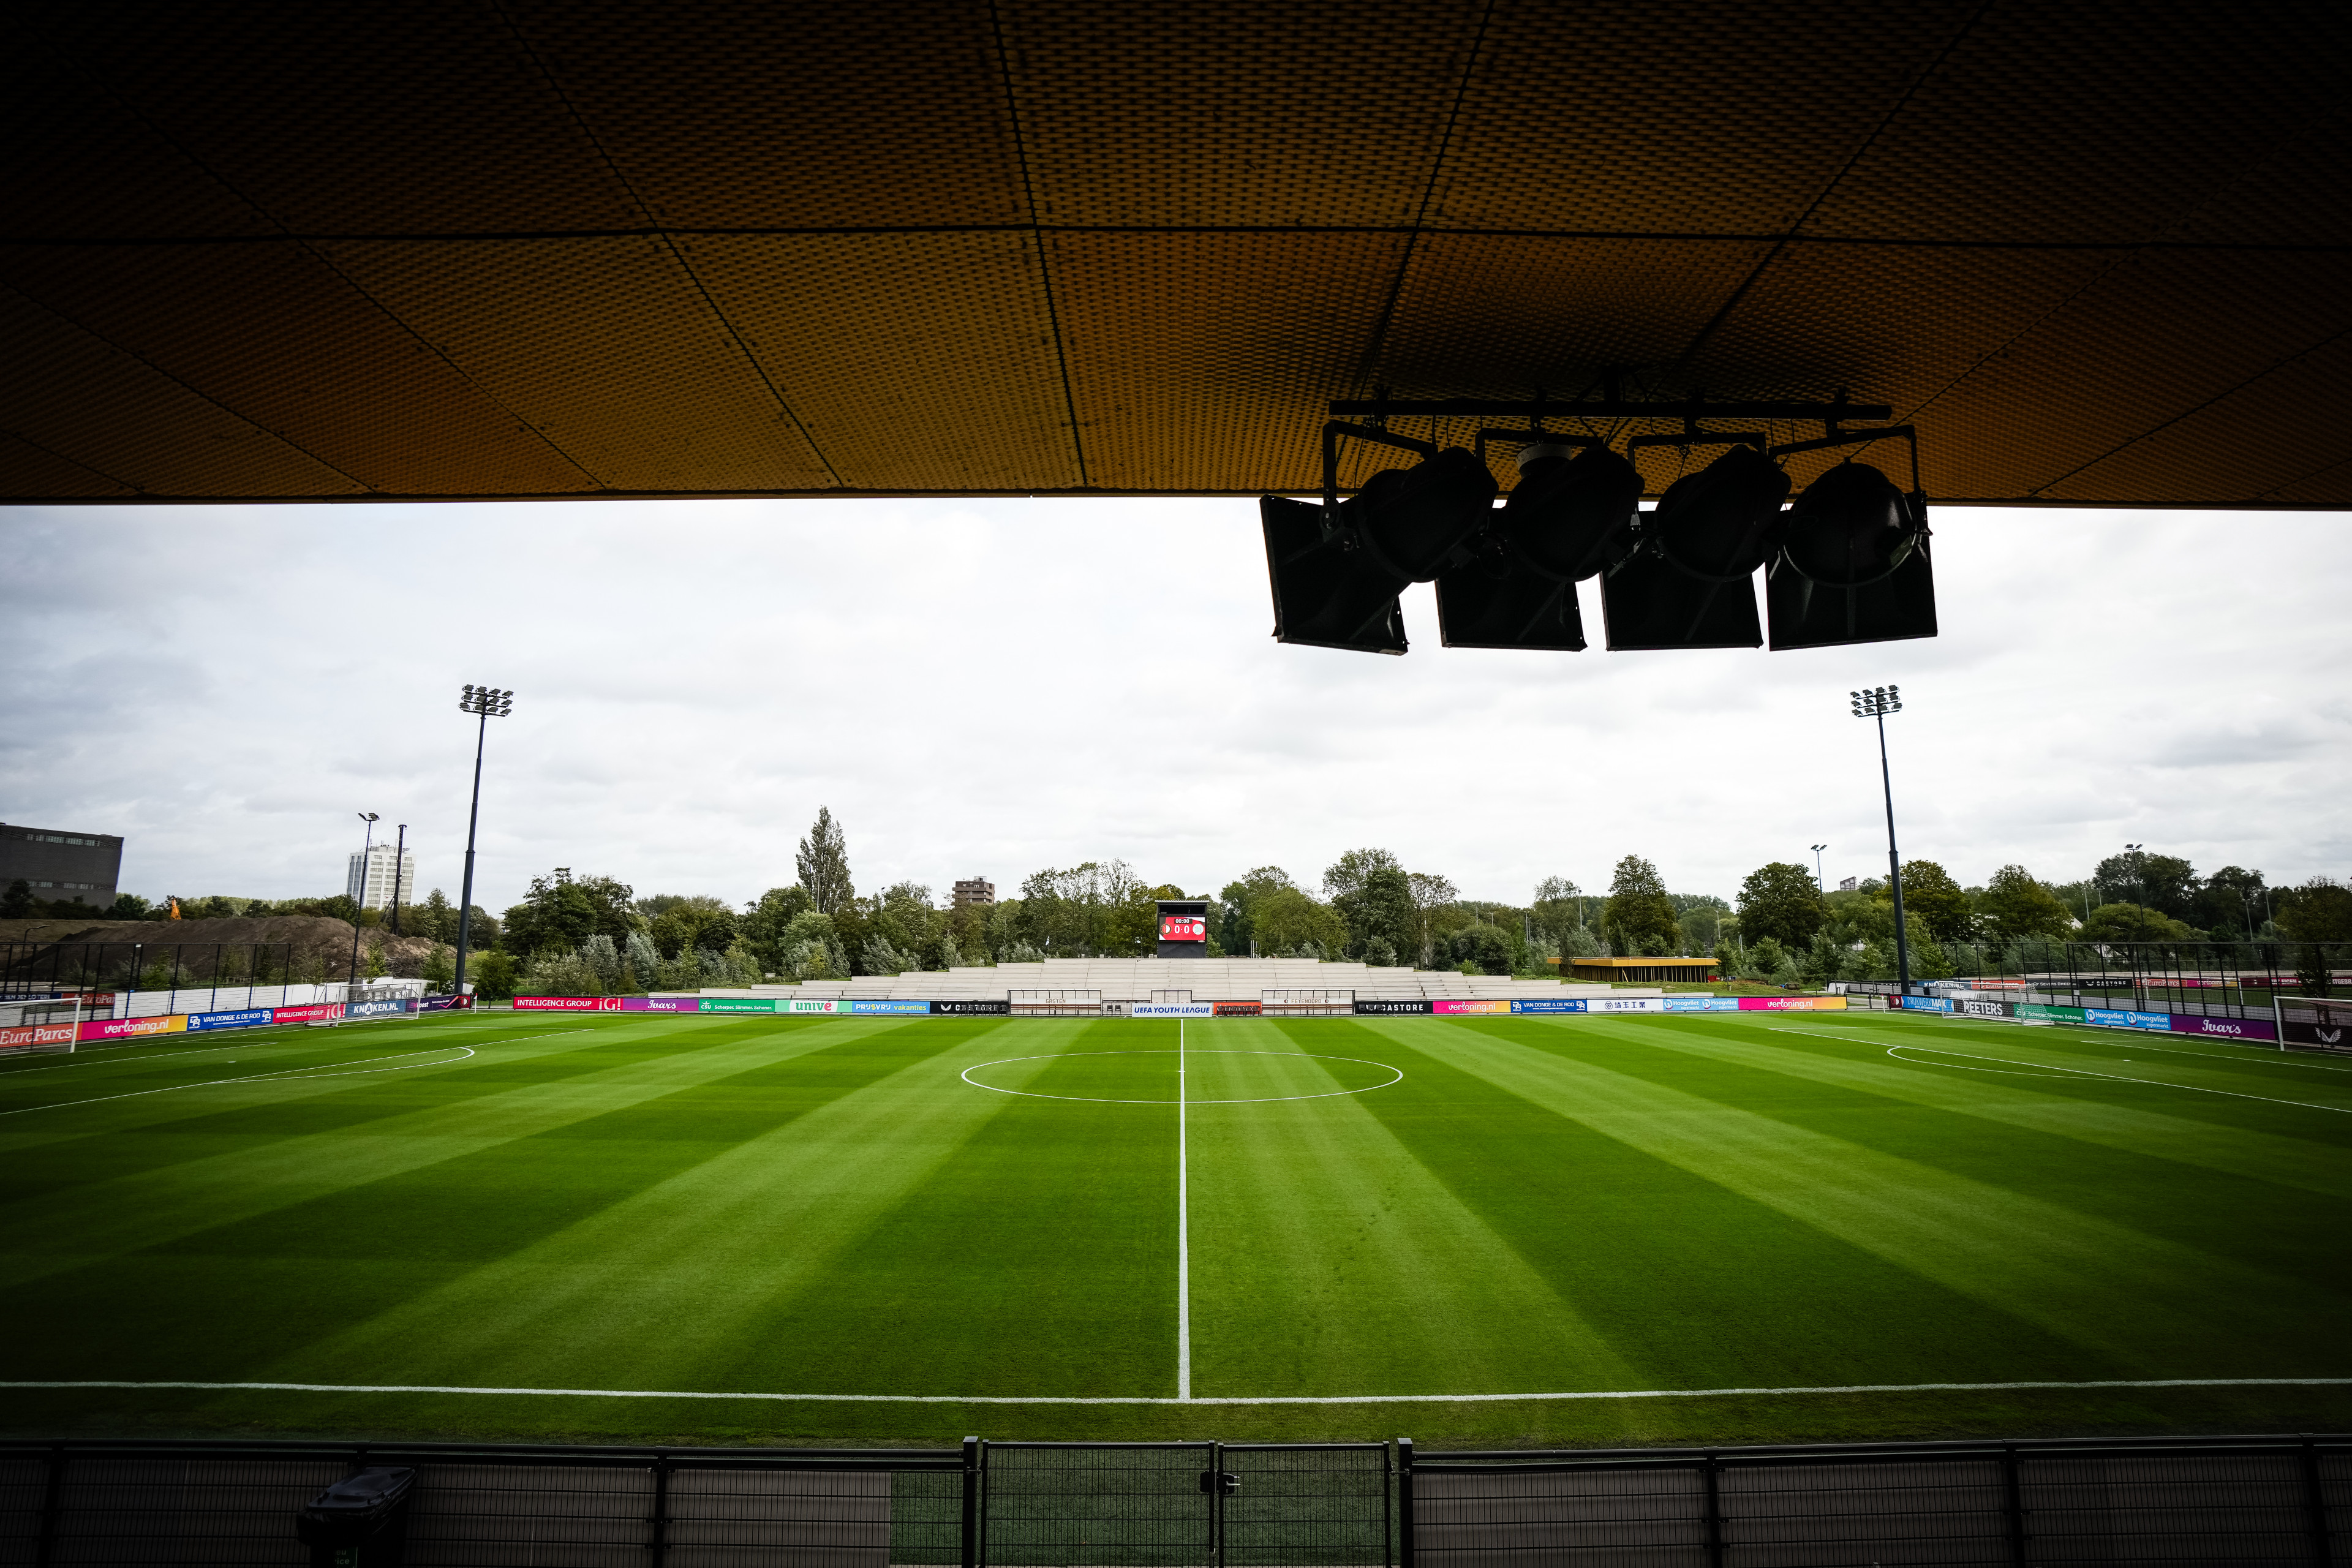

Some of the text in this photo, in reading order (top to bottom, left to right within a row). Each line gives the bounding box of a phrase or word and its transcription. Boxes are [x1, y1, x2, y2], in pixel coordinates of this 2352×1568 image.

[353, 1003, 398, 1014] KNAKEN.NL
[1448, 1001, 1496, 1012] verloning.nl
[1767, 998, 1813, 1009] verloning.nl
[1964, 1001, 2003, 1016] PEETERS
[2137, 1014, 2168, 1023] Hoogvliet
[104, 1019, 169, 1033] verloning.nl
[0, 1028, 72, 1044] EuroParcs
